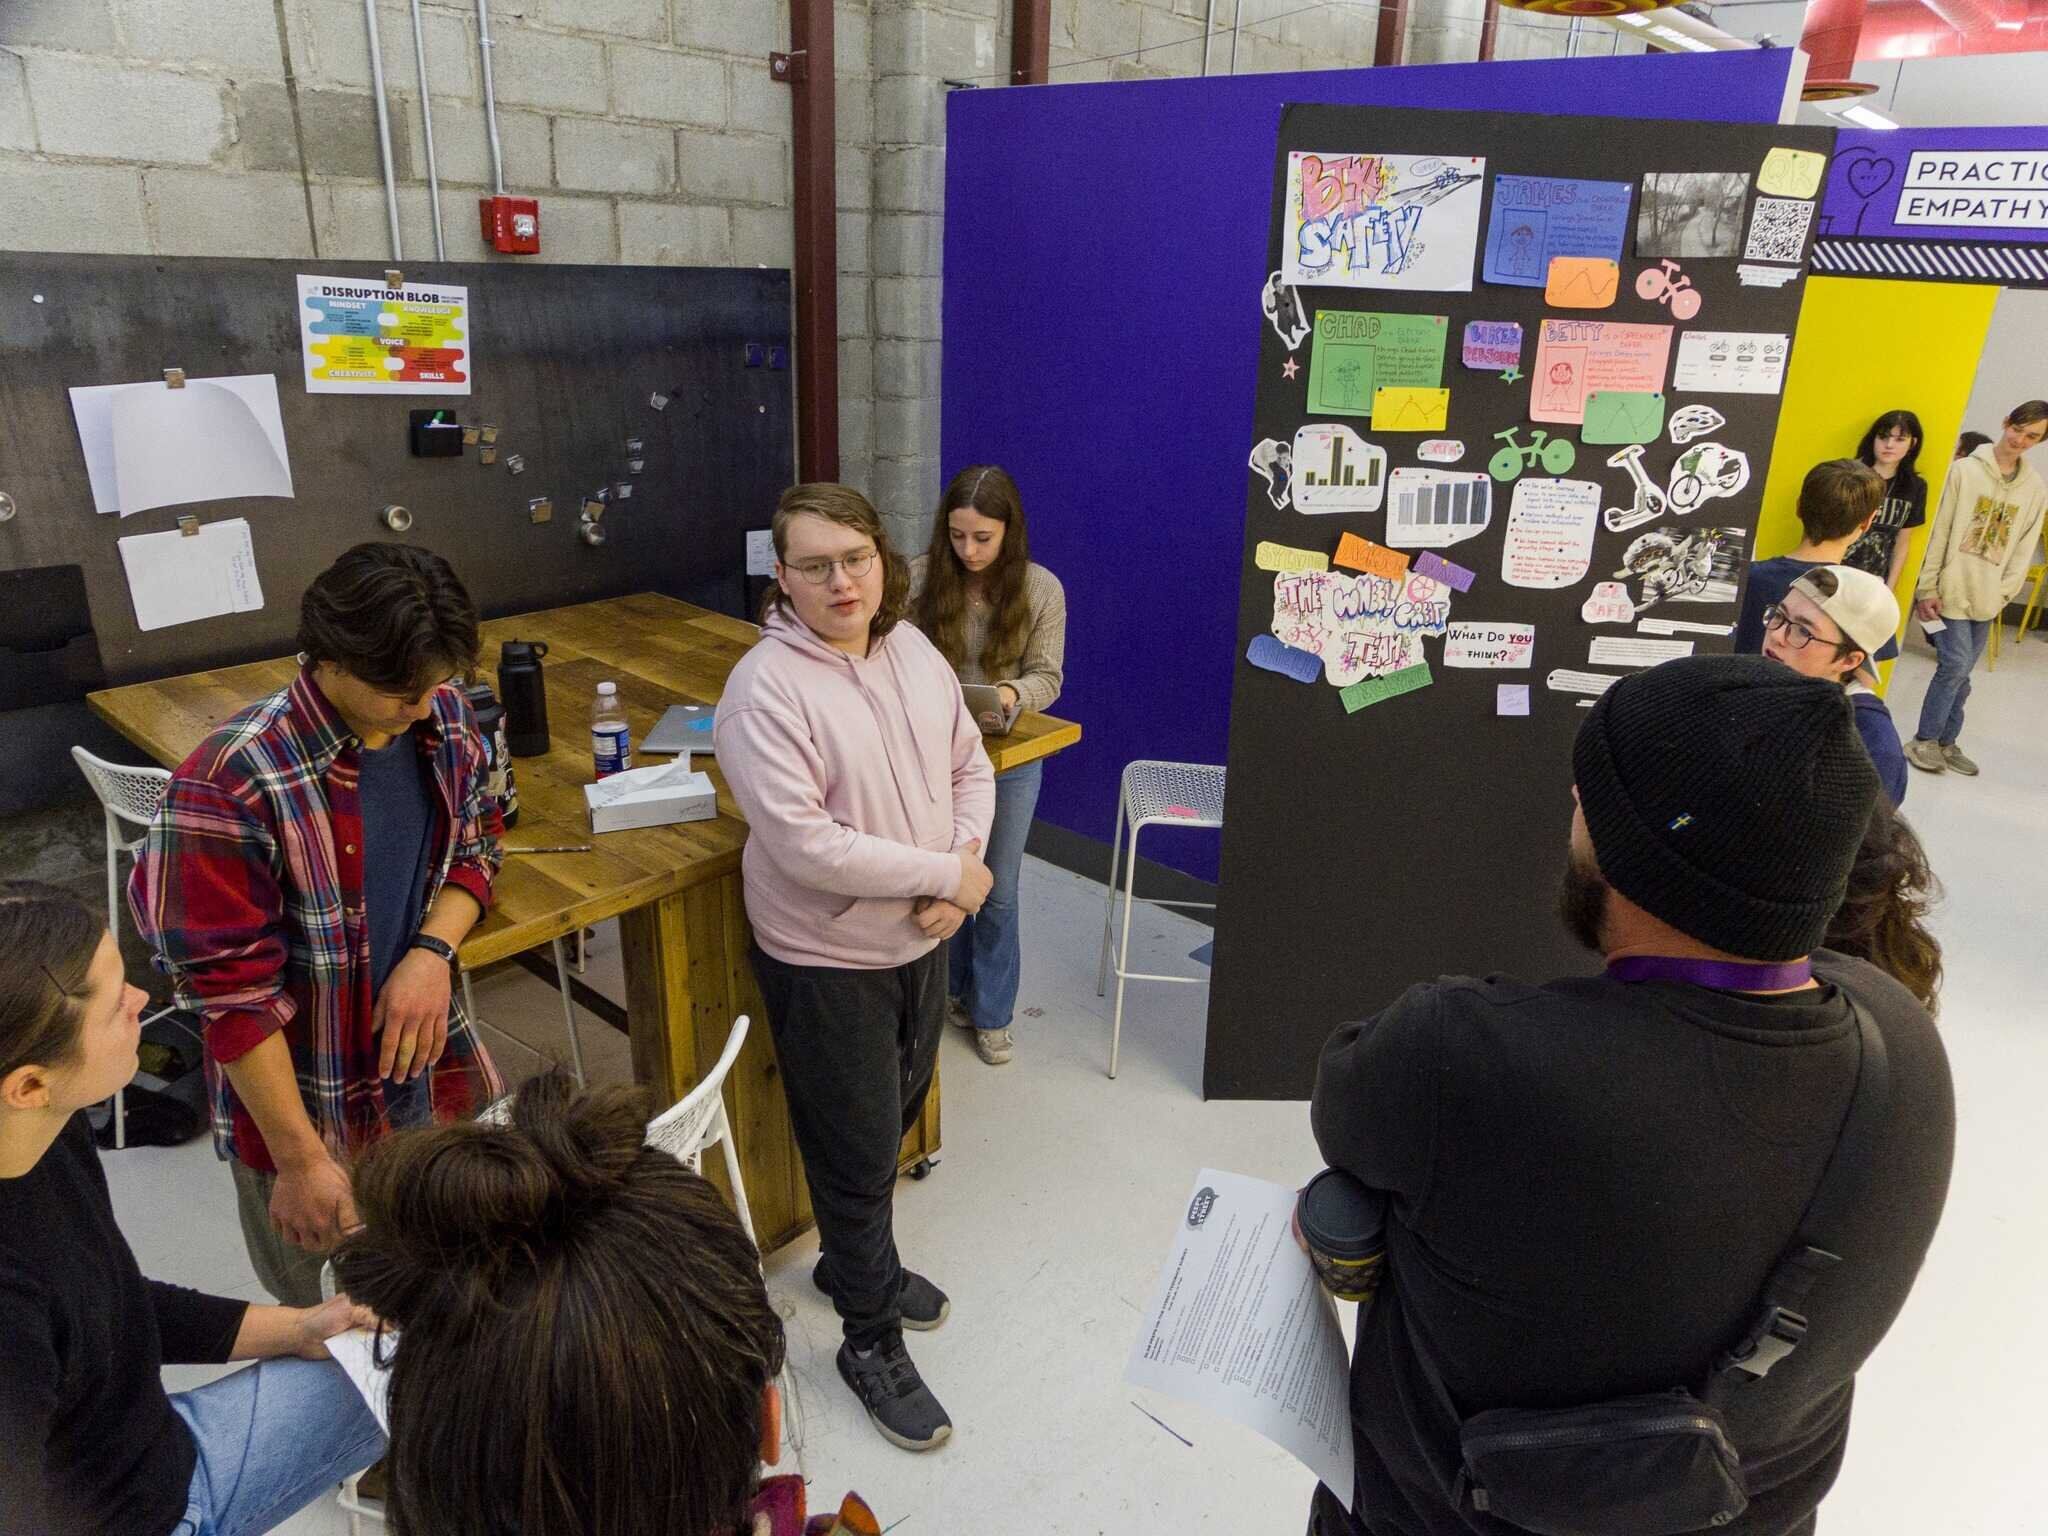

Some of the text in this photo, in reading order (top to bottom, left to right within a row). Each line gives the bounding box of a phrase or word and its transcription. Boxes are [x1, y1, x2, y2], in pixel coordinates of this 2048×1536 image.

[1300, 155, 1384, 220] BIKE
[1499, 180, 1577, 207] JAMES
[1908, 198, 2048, 219] EMPATHY
[322, 286, 405, 302] DISRUPTION
[408, 292, 440, 303] BLOB
[329, 300, 366, 310] MINDSET
[1320, 313, 1381, 339] CHAD
[1545, 321, 1604, 342] BETTY
[379, 338, 405, 346] VOICE
[419, 372, 445, 380] SKILLS
[1467, 650, 1508, 661] THINK?
